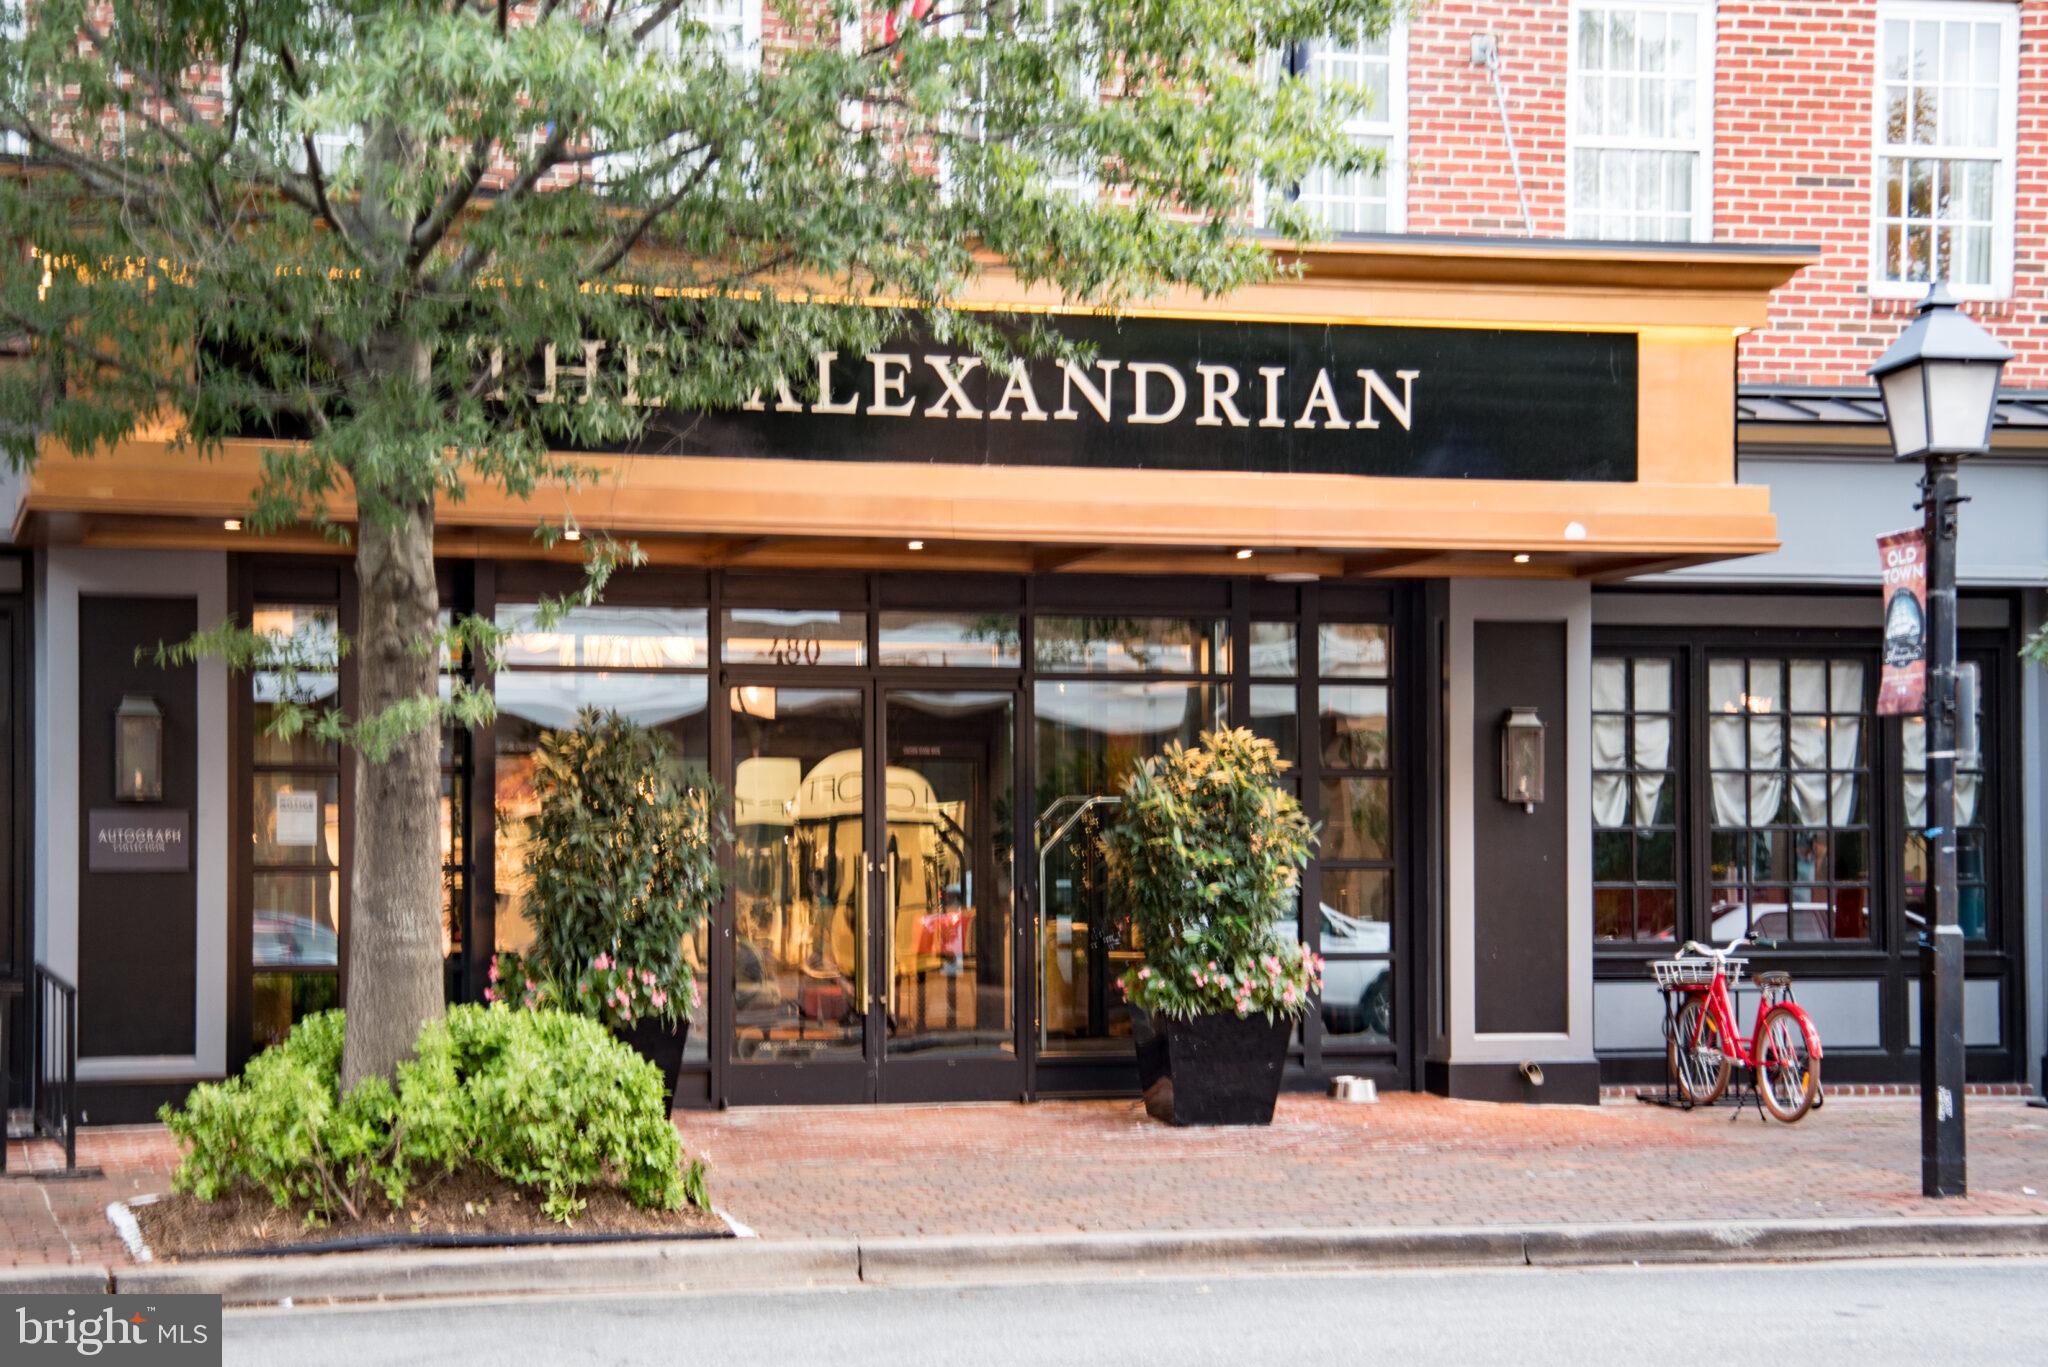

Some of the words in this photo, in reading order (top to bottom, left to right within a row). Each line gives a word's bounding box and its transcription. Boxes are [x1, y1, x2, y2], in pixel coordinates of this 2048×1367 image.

[1887, 545, 1918, 568] OLD
[1882, 561, 1925, 585] TOWN
[767, 634, 821, 668] 480
[98, 828, 182, 844] AUTOGRAPH
